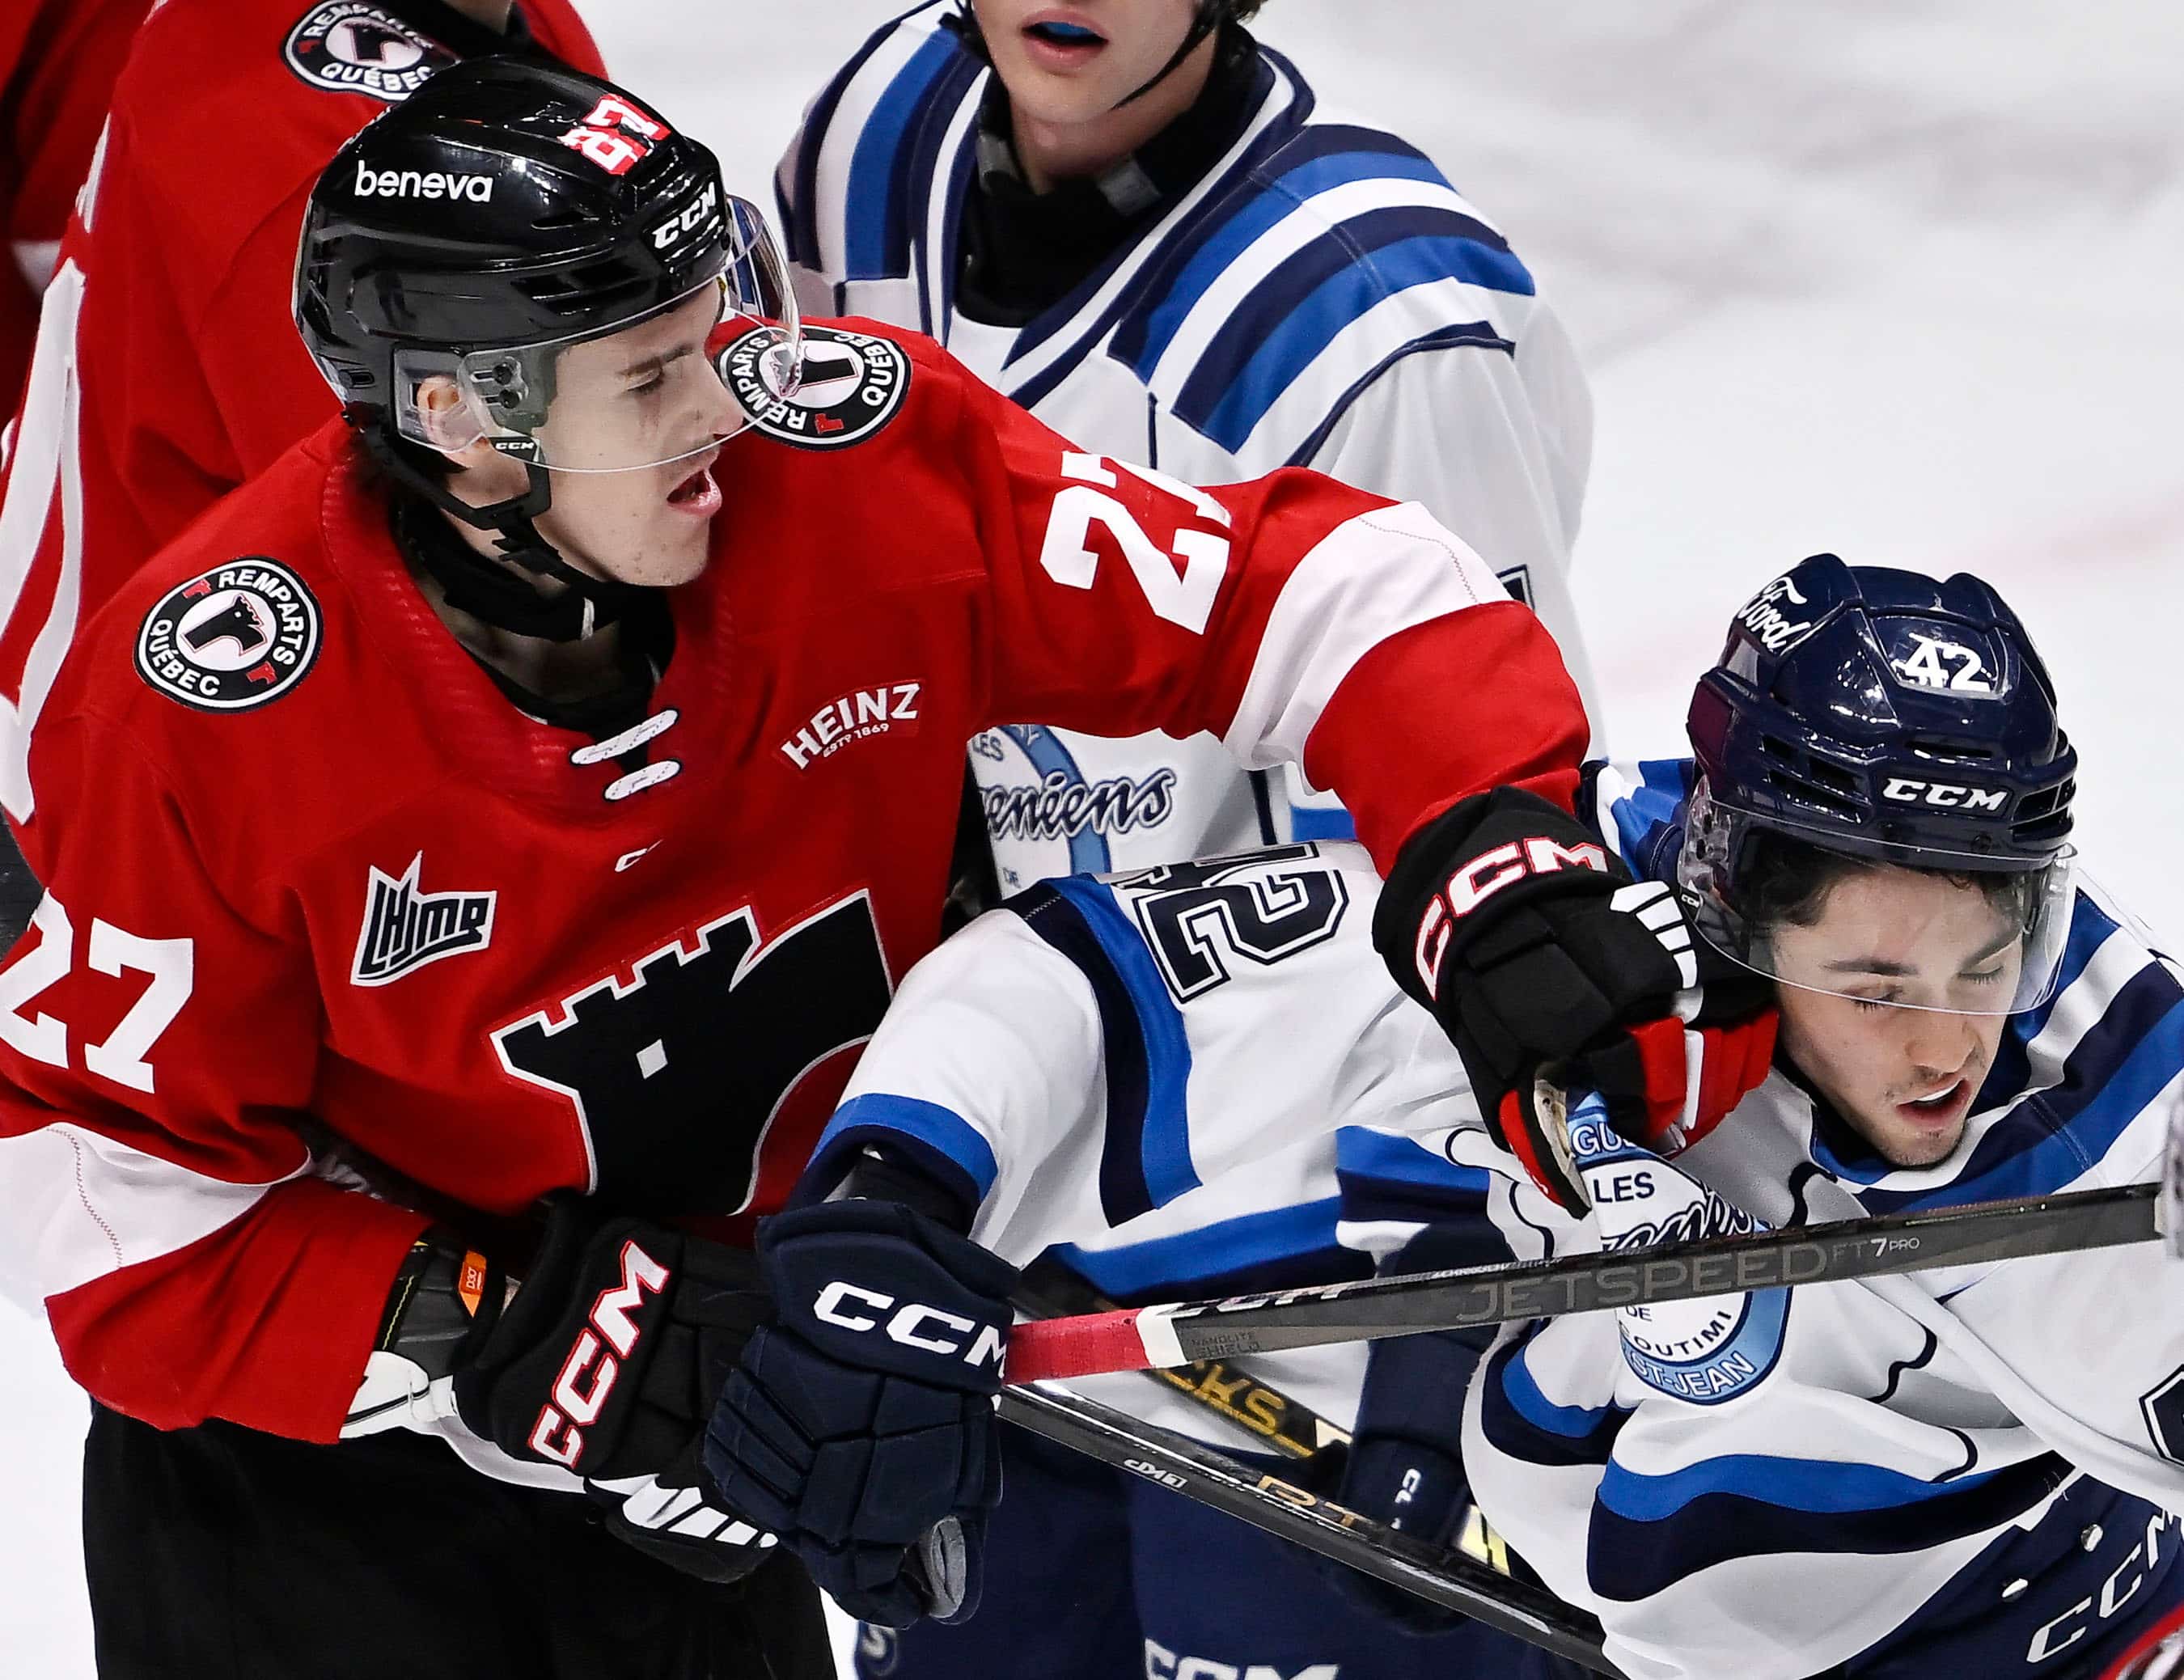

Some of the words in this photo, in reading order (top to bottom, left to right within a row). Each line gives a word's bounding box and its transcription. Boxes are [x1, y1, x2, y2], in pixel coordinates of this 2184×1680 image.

[320, 61, 435, 91] QUÉBEC
[354, 159, 493, 202] beneva
[652, 181, 716, 249] CCM
[731, 336, 807, 430] REMPARTS
[834, 333, 893, 406] QUÉBEC
[495, 442, 534, 450] CCM
[1039, 451, 1232, 635] 27
[218, 569, 304, 665] REMPARTS
[1739, 576, 1811, 650] Ford
[149, 620, 220, 696] QUÉBEC
[1901, 633, 1991, 692] 42
[781, 683, 921, 770] HEINZ
[853, 723, 890, 739] 1869
[1882, 777, 2008, 811] CCM
[1416, 836, 1610, 1001] CCM
[0, 887, 194, 1094] 27
[1594, 1171, 1655, 1204] LES
[1456, 1241, 1827, 1322] JETSPEED
[1625, 1305, 1653, 1322] DE
[527, 1239, 671, 1469] CCM
[812, 1280, 1007, 1379] CCM
[1619, 1310, 1732, 1356] OUTIMI
[1630, 1349, 1758, 1397] ST-JEAN
